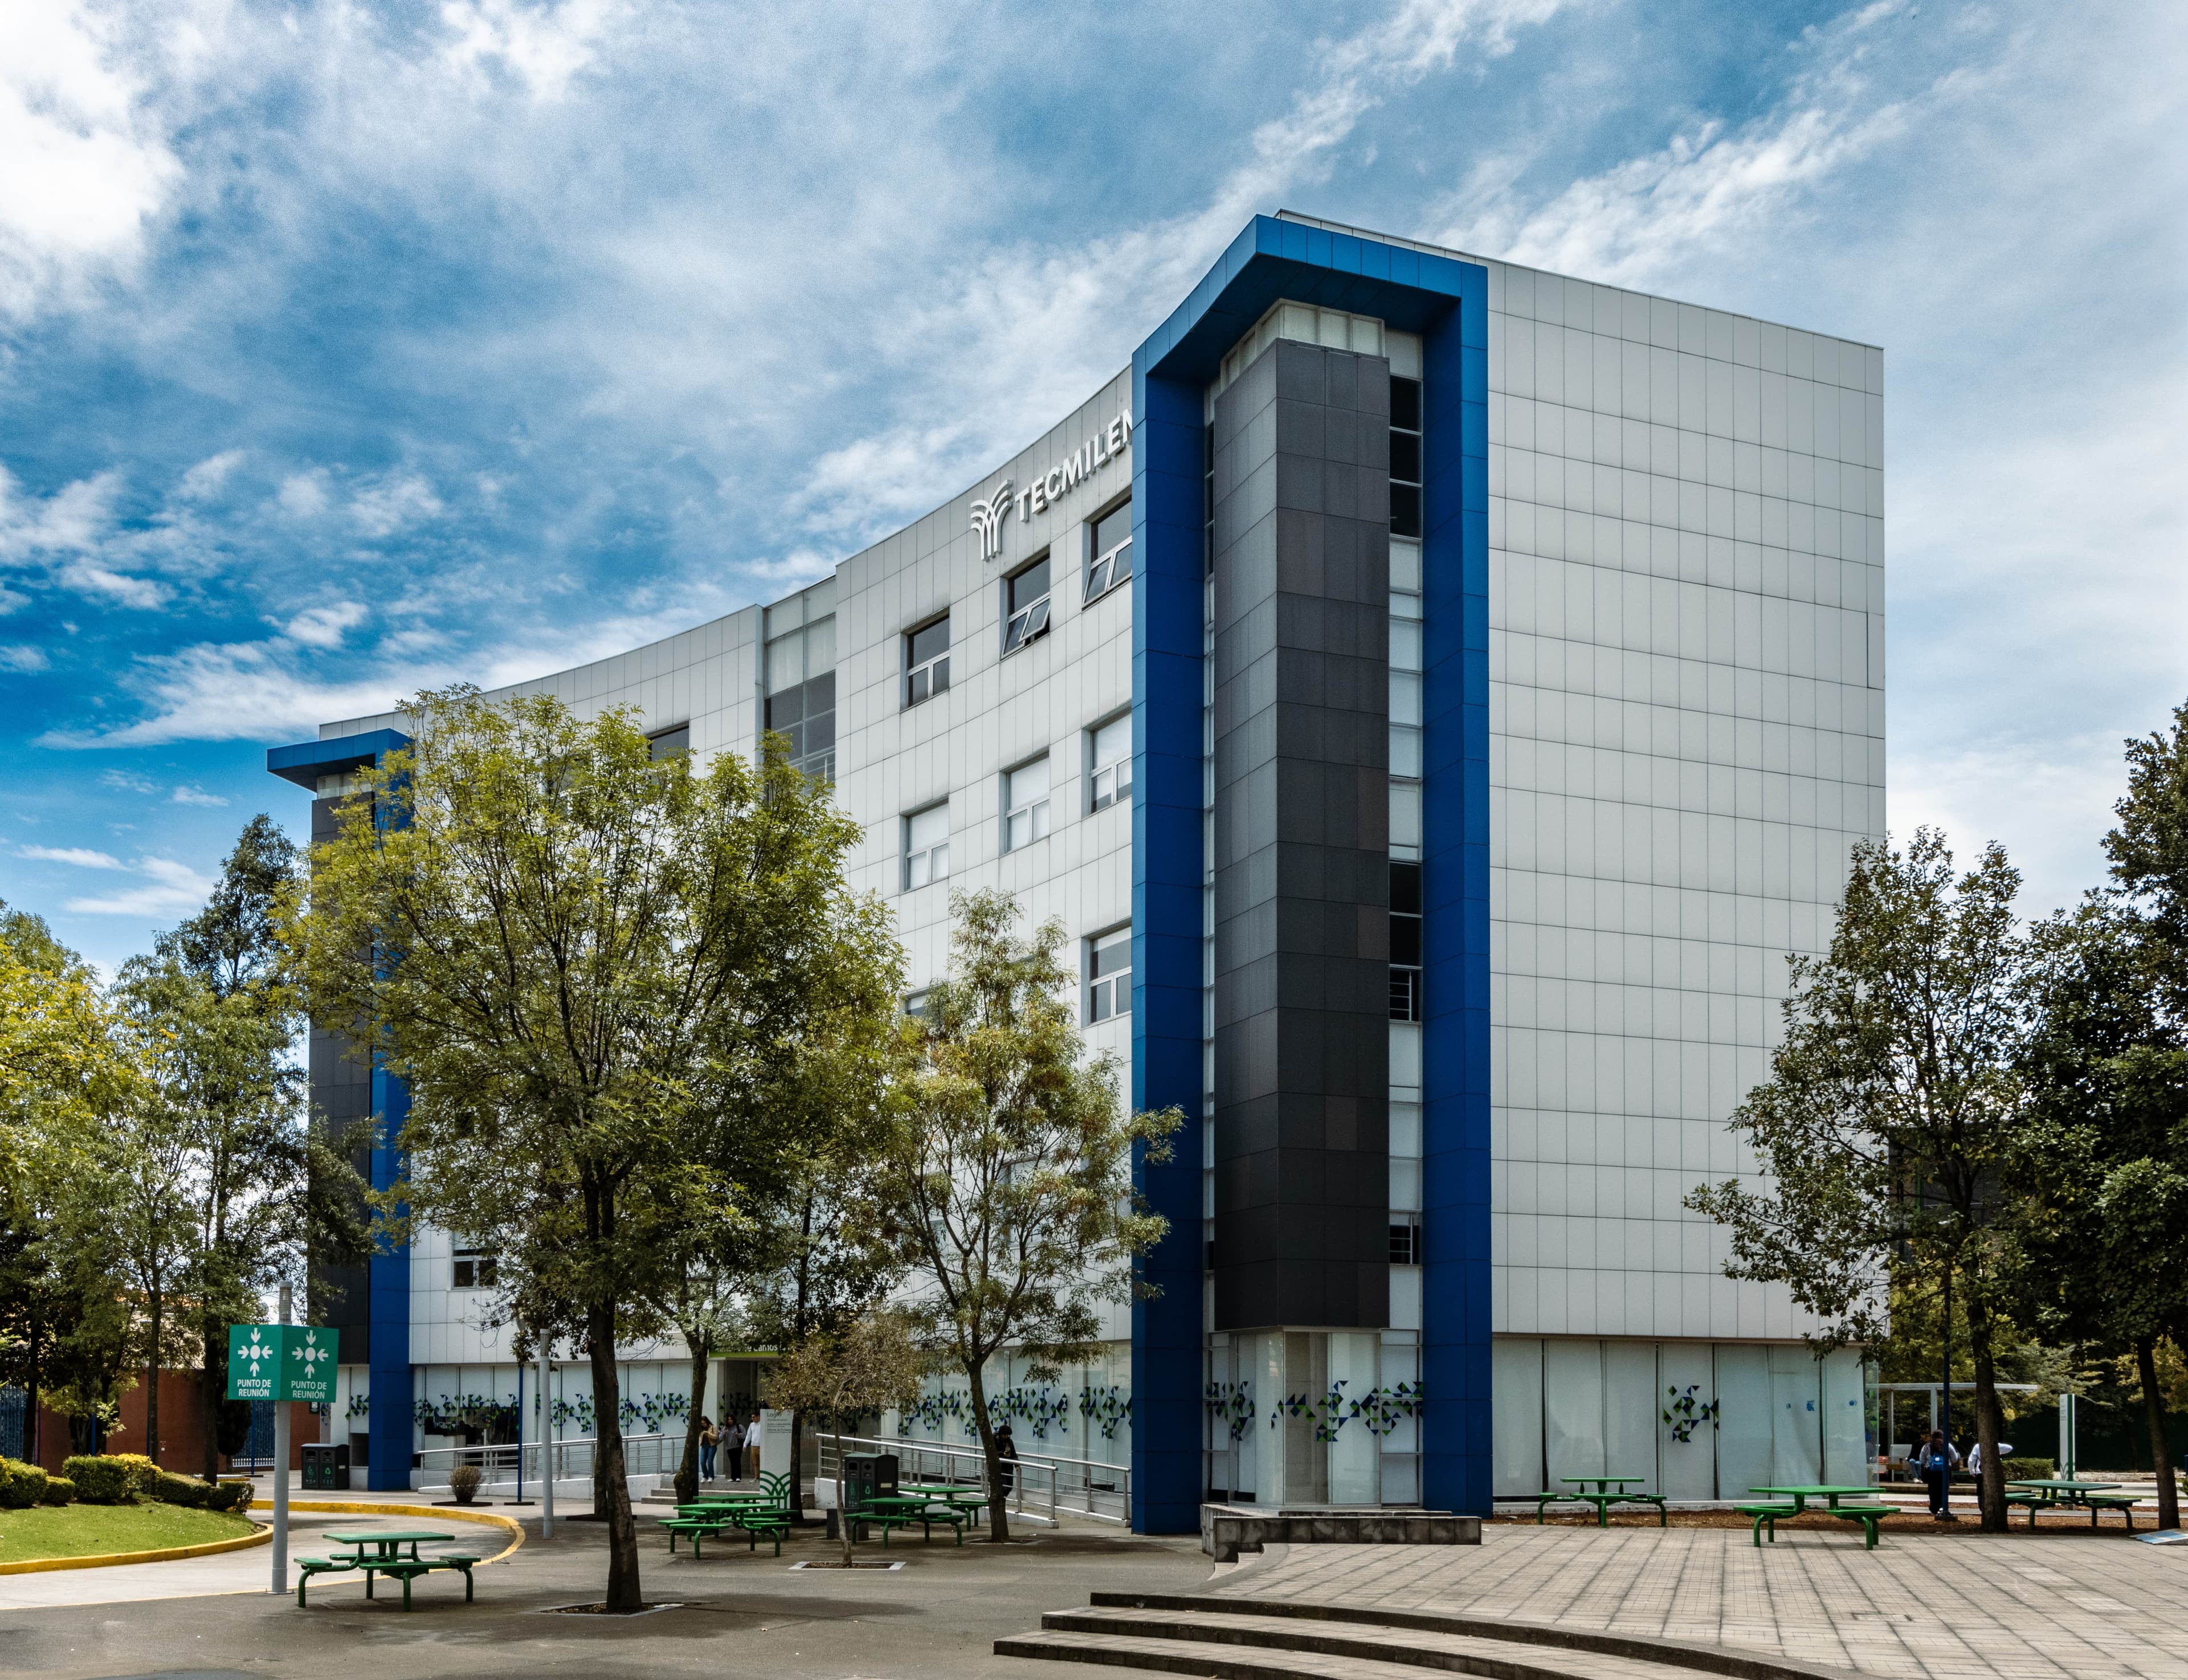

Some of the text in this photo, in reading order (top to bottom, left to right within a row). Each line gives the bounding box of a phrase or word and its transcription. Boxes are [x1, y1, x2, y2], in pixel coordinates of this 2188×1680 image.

[291, 1380, 316, 1389] PUNTO
[238, 1387, 270, 1397] REUNIÓN
[292, 1389, 325, 1399] REUNIÓN
